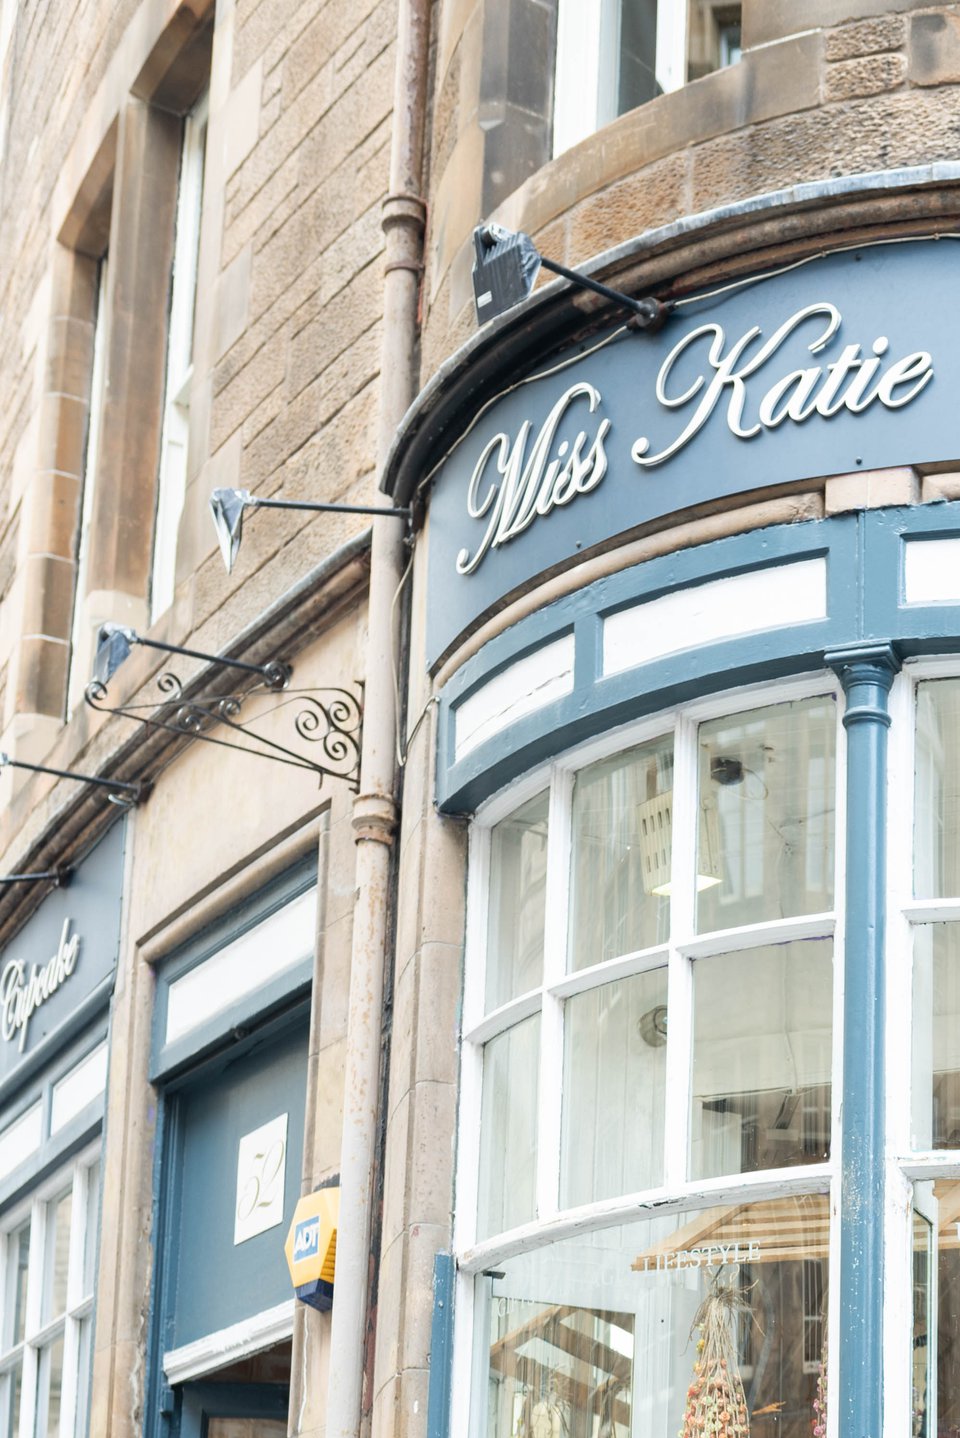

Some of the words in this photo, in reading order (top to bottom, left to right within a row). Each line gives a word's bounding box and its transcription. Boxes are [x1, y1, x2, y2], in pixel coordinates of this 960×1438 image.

[455, 382, 612, 575] Miss
[631, 302, 935, 467] Katie
[0, 916, 81, 1054] Cupcake
[238, 1139, 285, 1222] 52
[294, 1223, 320, 1256] ADT
[643, 1240, 762, 1274] LIFESTYLE
